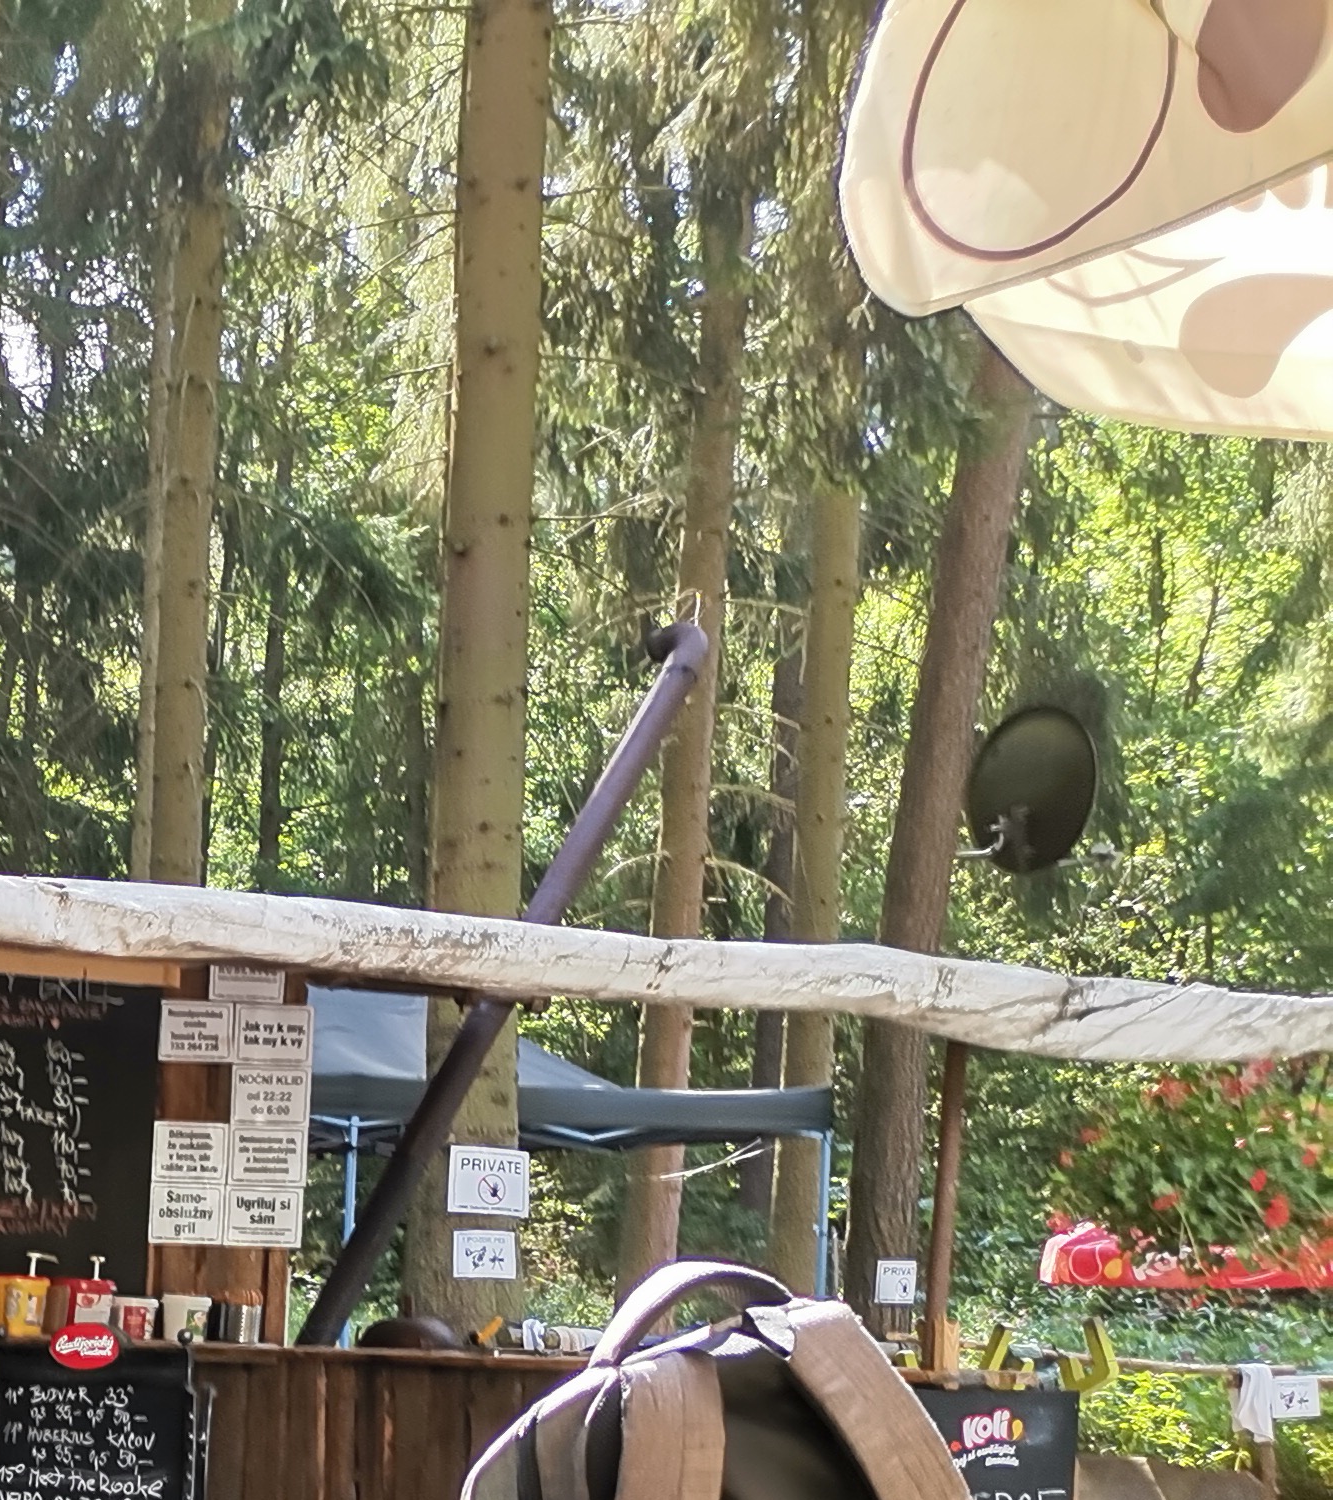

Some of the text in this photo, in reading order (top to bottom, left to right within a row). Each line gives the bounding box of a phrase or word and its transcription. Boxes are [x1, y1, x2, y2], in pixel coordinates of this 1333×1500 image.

[239, 1073, 304, 1086] NOČNÍ KLID
[247, 1091, 292, 1102] od 22:22
[251, 1105, 290, 1116] do 6:00
[461, 1158, 521, 1175] PRIVATE
[166, 1190, 207, 1203] Samo-
[280, 1198, 291, 1210] si
[159, 1205, 213, 1221] obslužný
[250, 1213, 275, 1225] sám
[174, 1222, 196, 1236] gril
[30, 1385, 93, 1406] BUDVAR
[27, 1426, 94, 1445] HUBERTUS
[963, 1410, 1010, 1448] Koli
[28, 1466, 65, 1488] Meet
[68, 1470, 96, 1492] the
